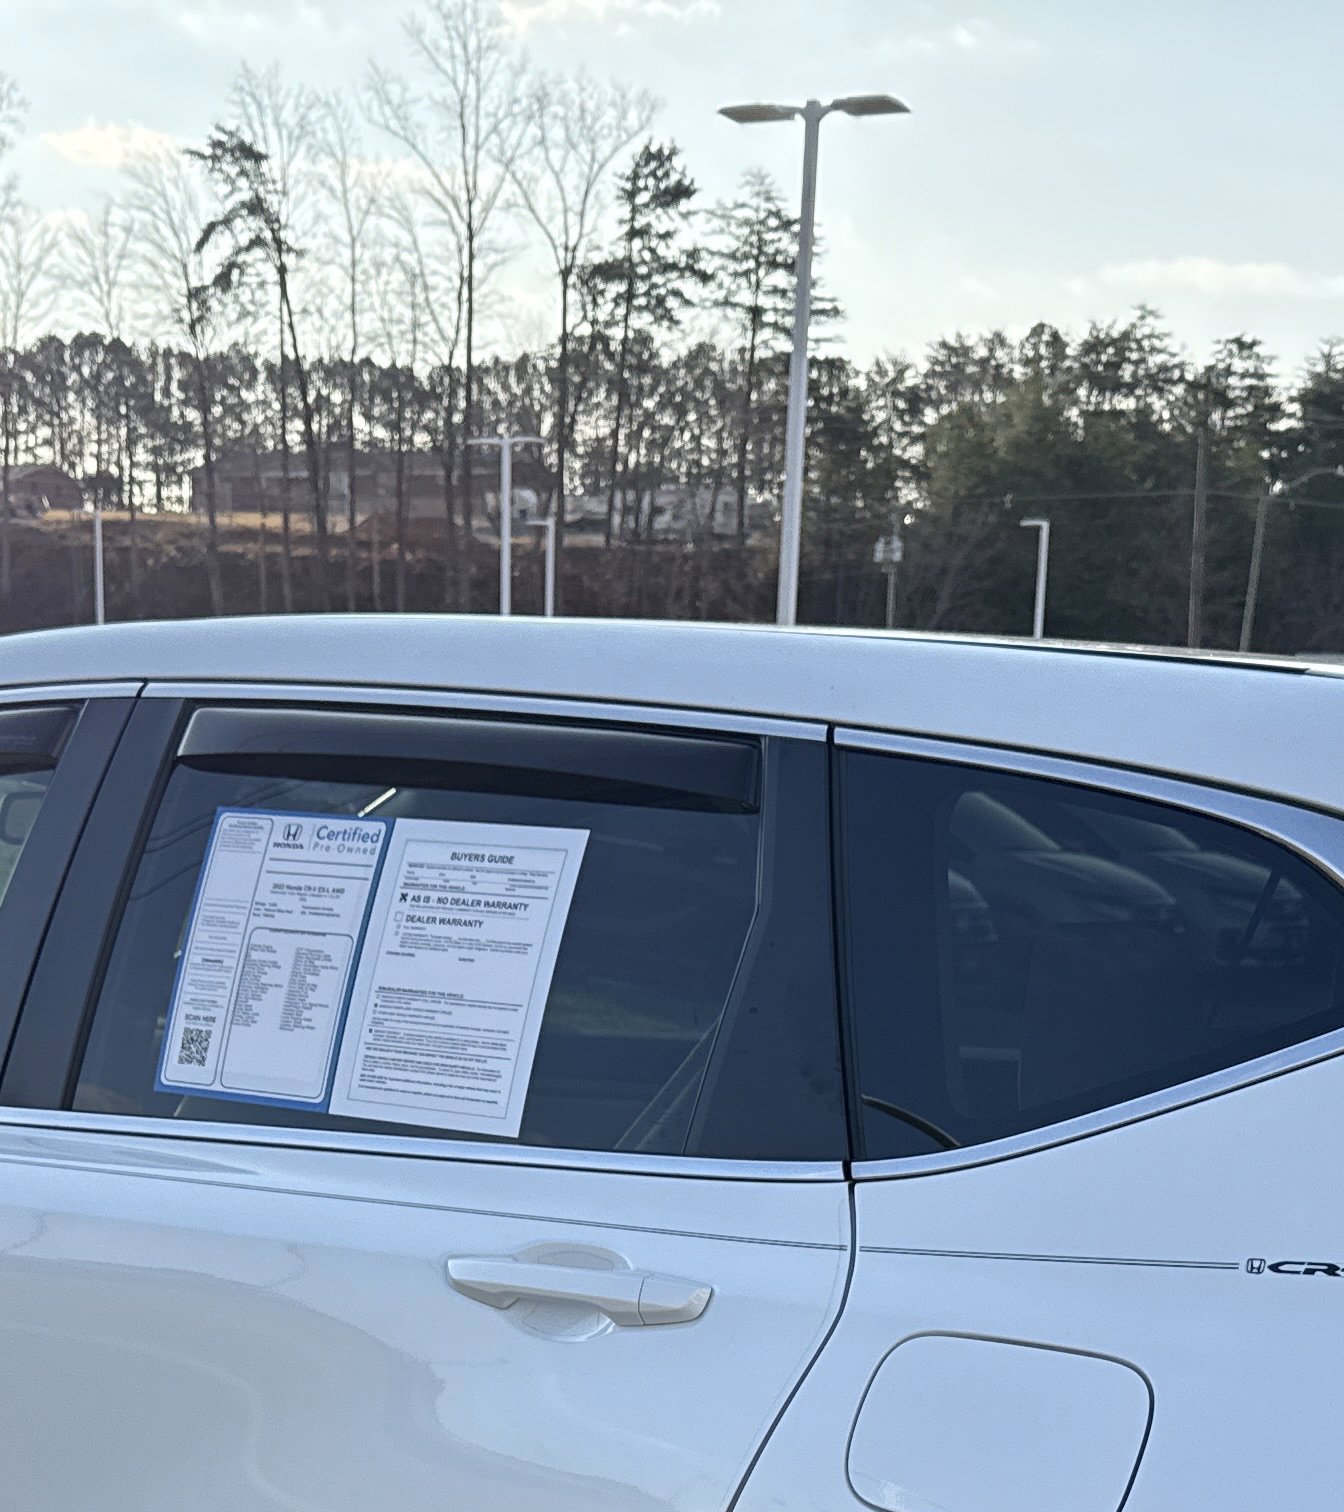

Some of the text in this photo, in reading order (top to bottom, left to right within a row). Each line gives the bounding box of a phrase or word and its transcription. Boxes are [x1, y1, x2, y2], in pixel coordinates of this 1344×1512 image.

[316, 824, 382, 844] Certified
[272, 841, 305, 850] HONDA
[312, 842, 377, 856] Pre Owned
[487, 855, 515, 865] GUIDE
[410, 894, 422, 903] AS
[422, 896, 432, 904] IS
[436, 896, 449, 905] NO
[450, 898, 482, 908] DEALER
[484, 901, 530, 912] WARRANTY
[405, 914, 485, 929] DEALER WARRANTY
